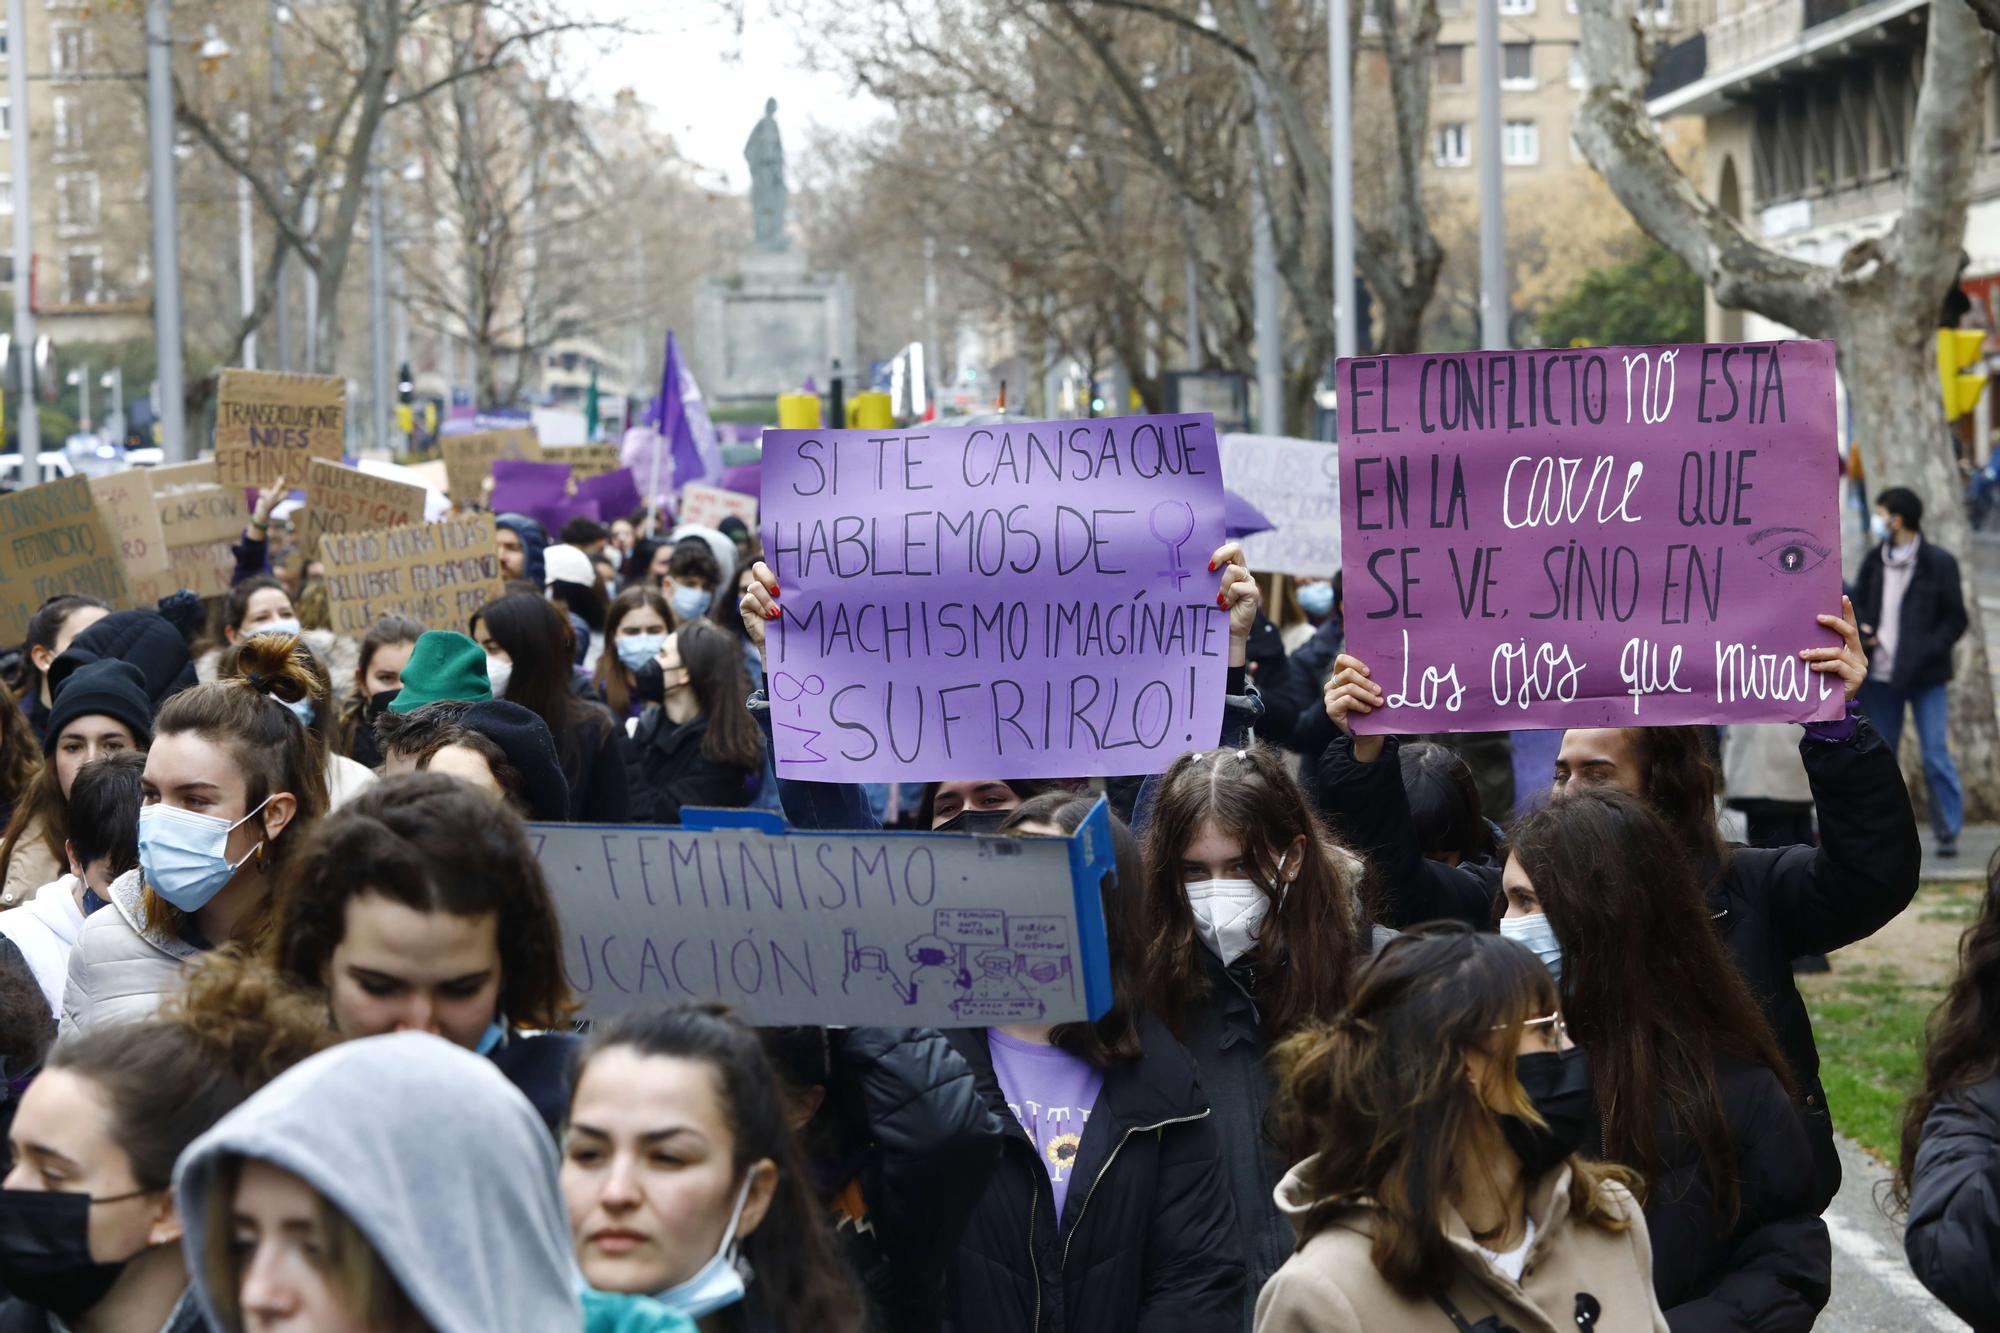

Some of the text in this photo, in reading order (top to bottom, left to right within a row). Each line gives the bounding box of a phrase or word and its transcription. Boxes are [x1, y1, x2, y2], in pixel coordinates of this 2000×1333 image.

[1350, 360, 1400, 435] EL
[1419, 354, 1607, 434] CONFLICTO
[792, 422, 1206, 496] SI TE CANSA QUE
[1355, 449, 1758, 531] EN LA carne QUE
[308, 508, 347, 535] NO
[312, 486, 409, 528] JUSTICIA
[775, 504, 1136, 579] HABLEMOS DE
[1366, 547, 1423, 620] SE
[1661, 543, 1722, 625] EN
[779, 589, 1222, 664] MACHISMO IMAGÍNATE
[1619, 637, 1693, 716] que
[829, 667, 1196, 764] SUFRIRLO!
[600, 834, 938, 912] FEMINISMO
[562, 928, 819, 998] UCACIÓN
